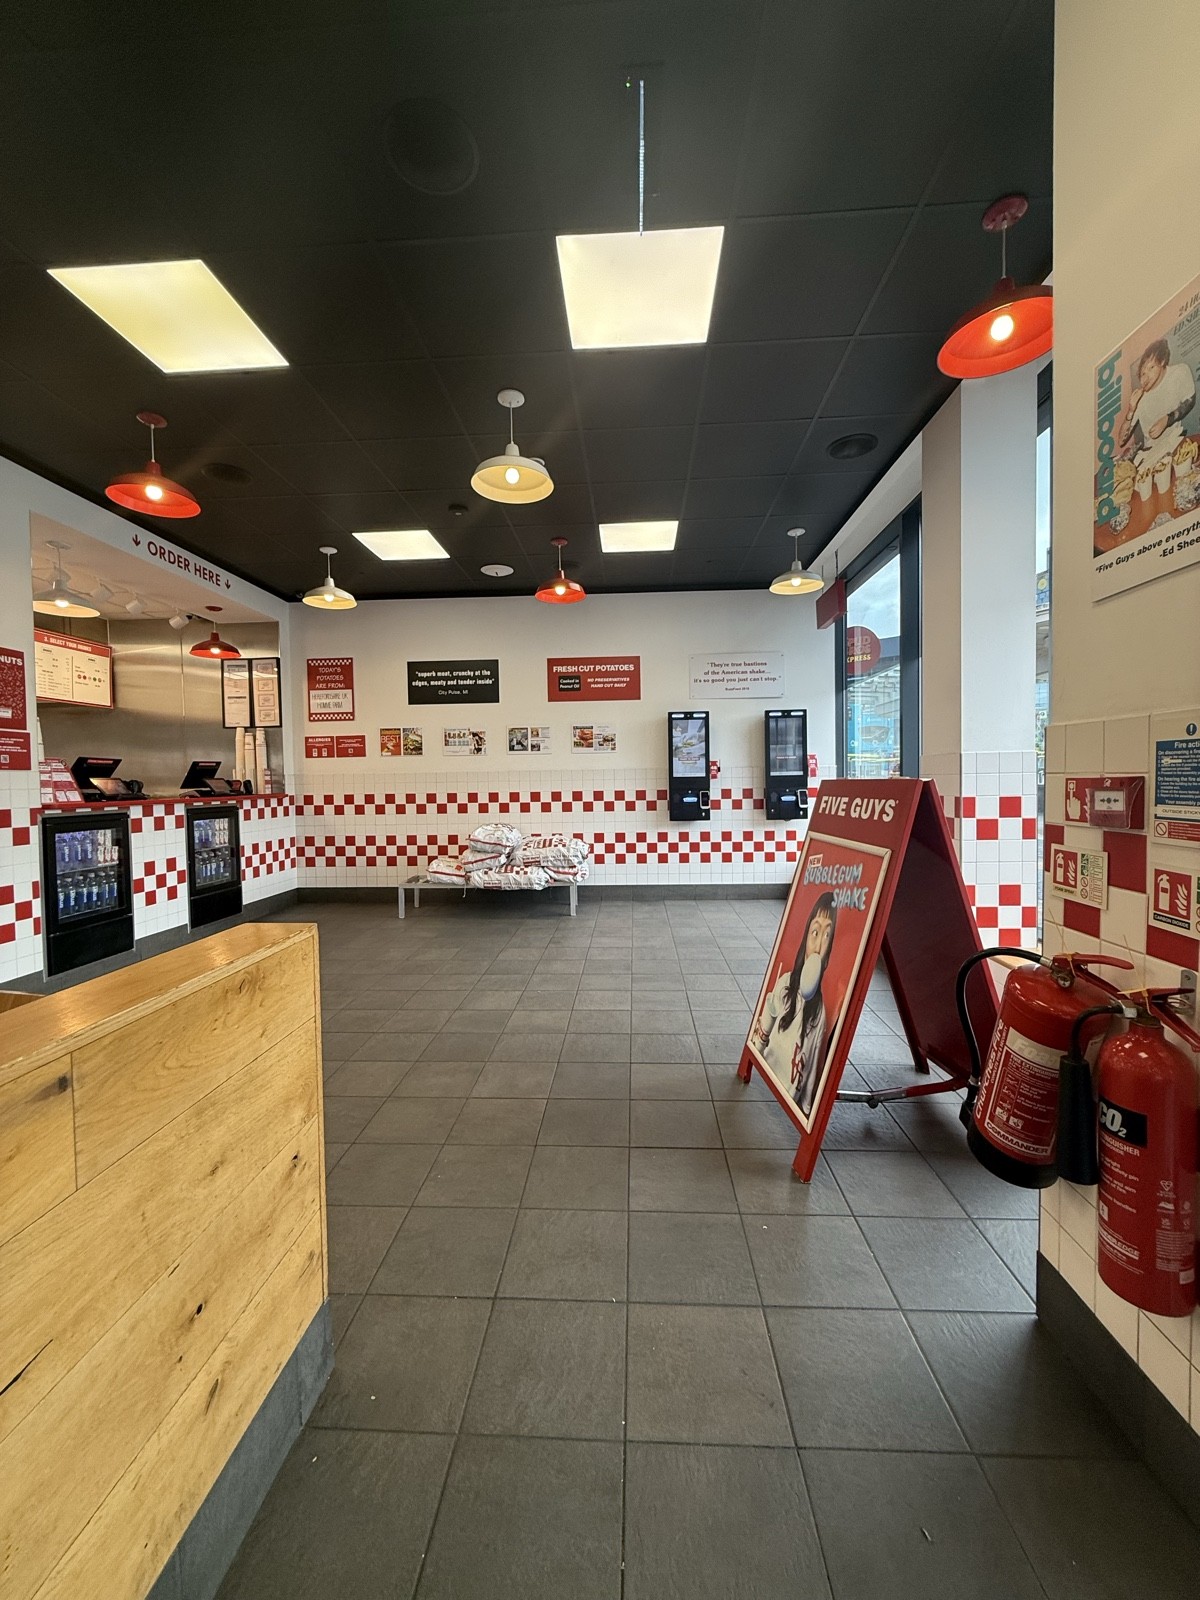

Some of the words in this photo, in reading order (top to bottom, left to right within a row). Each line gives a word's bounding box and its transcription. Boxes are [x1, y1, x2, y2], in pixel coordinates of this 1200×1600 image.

[1116, 551, 1134, 566] Guys
[1136, 539, 1162, 556] above
[1165, 519, 1200, 544] everyth
[147, 540, 191, 573] ORDER
[194, 562, 221, 587] HERE
[0, 655, 23, 666] NUTS
[381, 735, 400, 743] BEST
[818, 796, 849, 816] FIVE
[850, 798, 896, 822] GUYS
[810, 856, 821, 866] NEW
[804, 863, 864, 886] BUBBLEGUM
[831, 887, 869, 911] SHAKE
[1154, 914, 1172, 924] CARBON
[1172, 918, 1189, 929] DIOXIDE
[976, 1053, 996, 1119] Churches
[992, 1019, 1004, 1051] Fire
[1022, 1061, 1058, 1078] EXTINGUISHE
[986, 1121, 1048, 1155] COMMANDER
